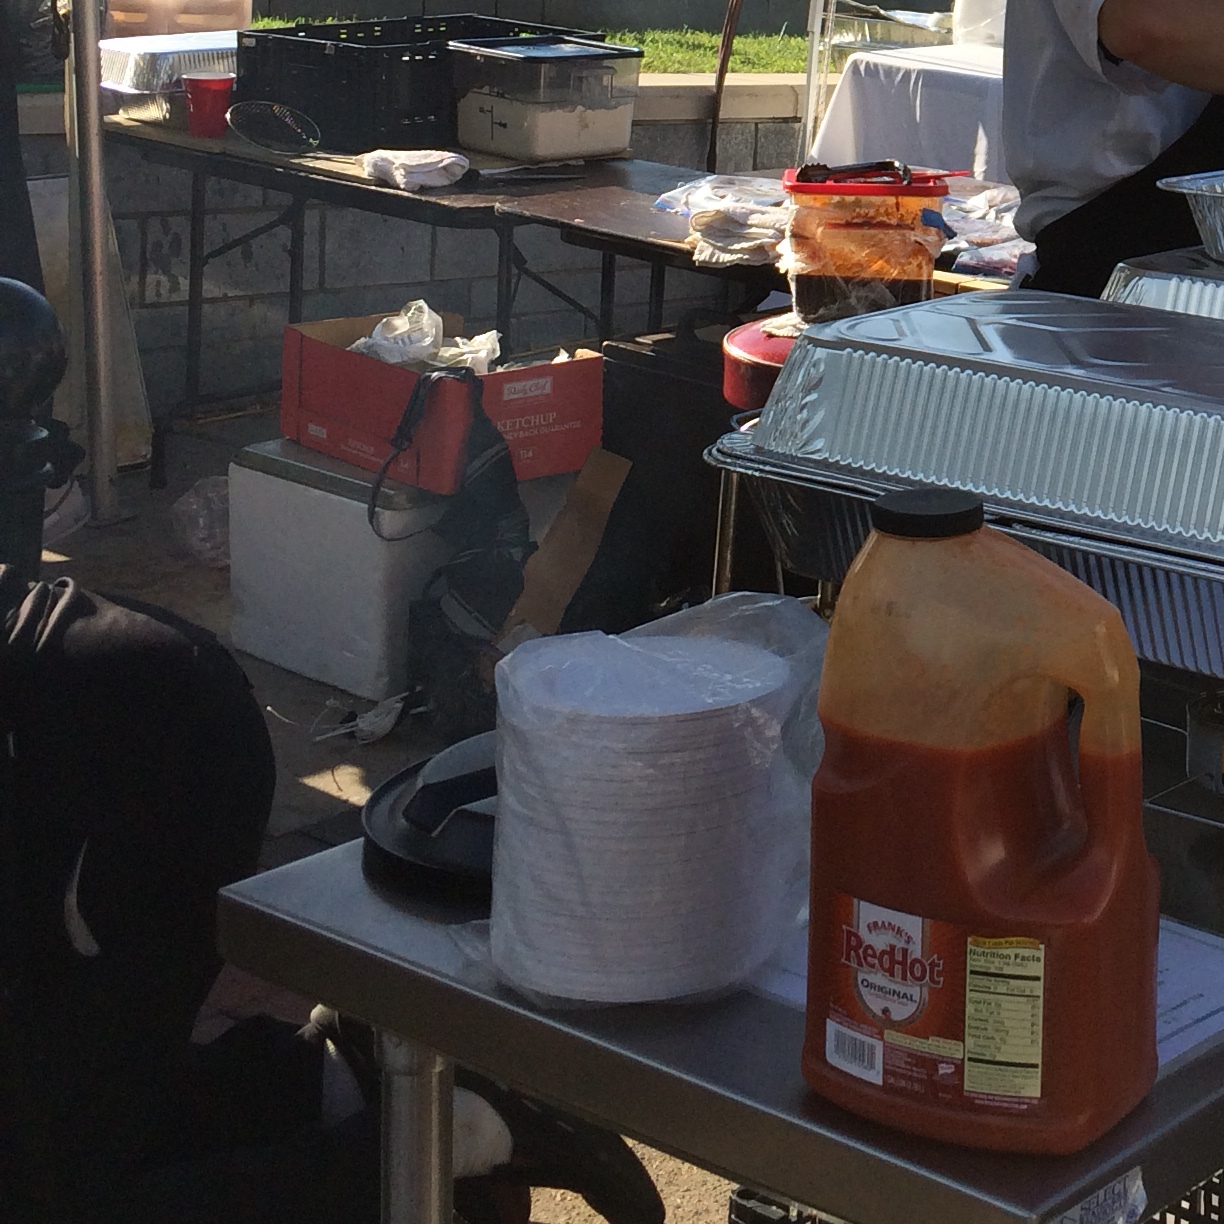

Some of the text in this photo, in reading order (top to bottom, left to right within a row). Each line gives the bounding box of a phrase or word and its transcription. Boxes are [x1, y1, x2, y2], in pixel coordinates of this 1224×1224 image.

[497, 412, 557, 432] KETCHUP
[866, 919, 914, 945] FRANK'S
[842, 926, 944, 987] RedHot
[969, 948, 1041, 963] Nutrition Facts
[860, 978, 917, 1002] ORIGINAL
